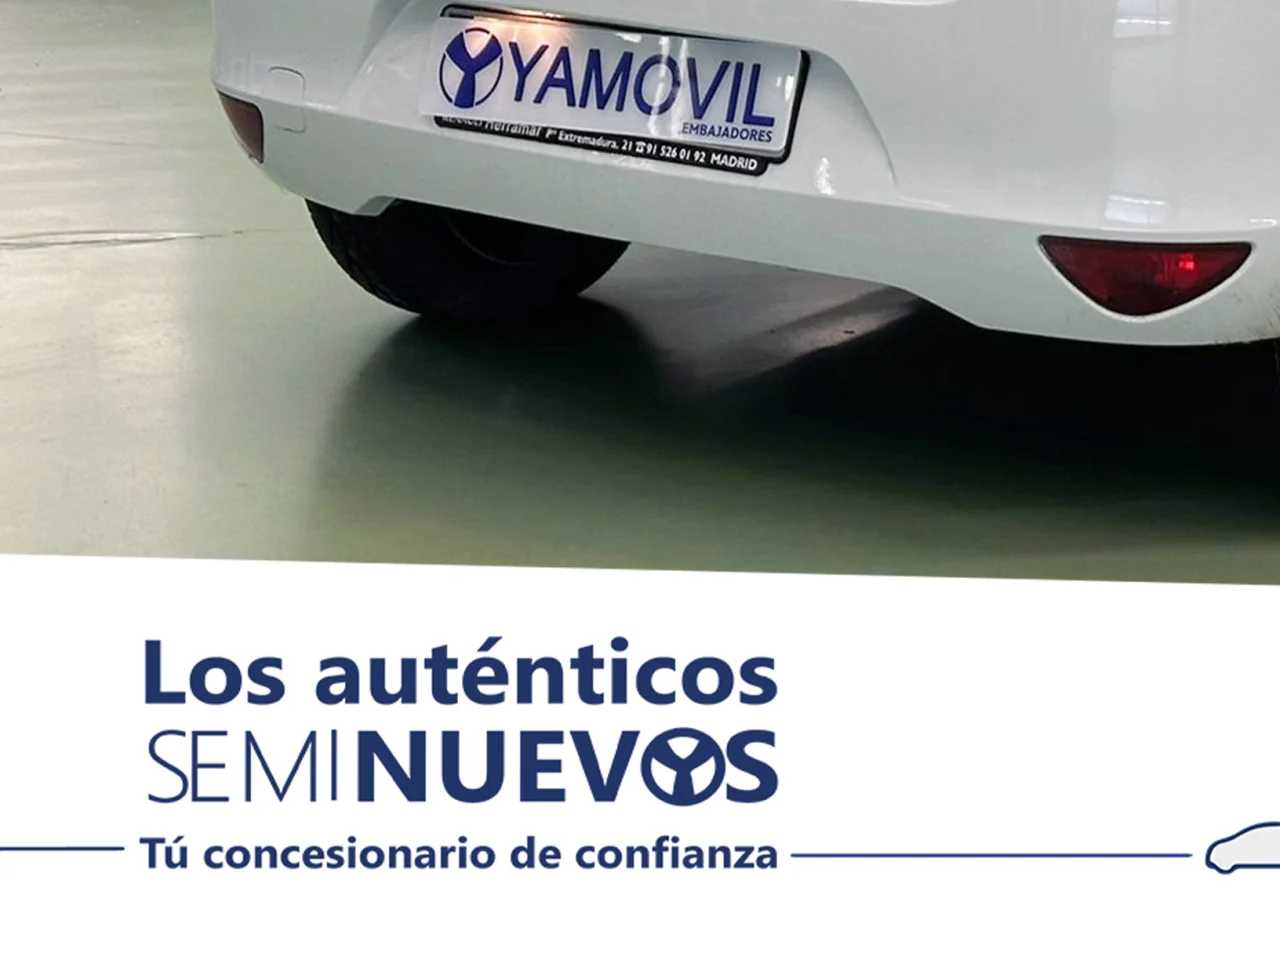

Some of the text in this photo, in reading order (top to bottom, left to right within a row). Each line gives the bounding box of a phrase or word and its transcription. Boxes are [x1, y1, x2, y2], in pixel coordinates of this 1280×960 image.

[508, 41, 776, 127] YAMOVIL
[682, 121, 774, 143] EMBAJADORES
[621, 139, 633, 152] 21
[660, 145, 678, 159] 526
[679, 148, 691, 161] 01
[693, 150, 706, 164] 92
[710, 152, 758, 171] MADRID
